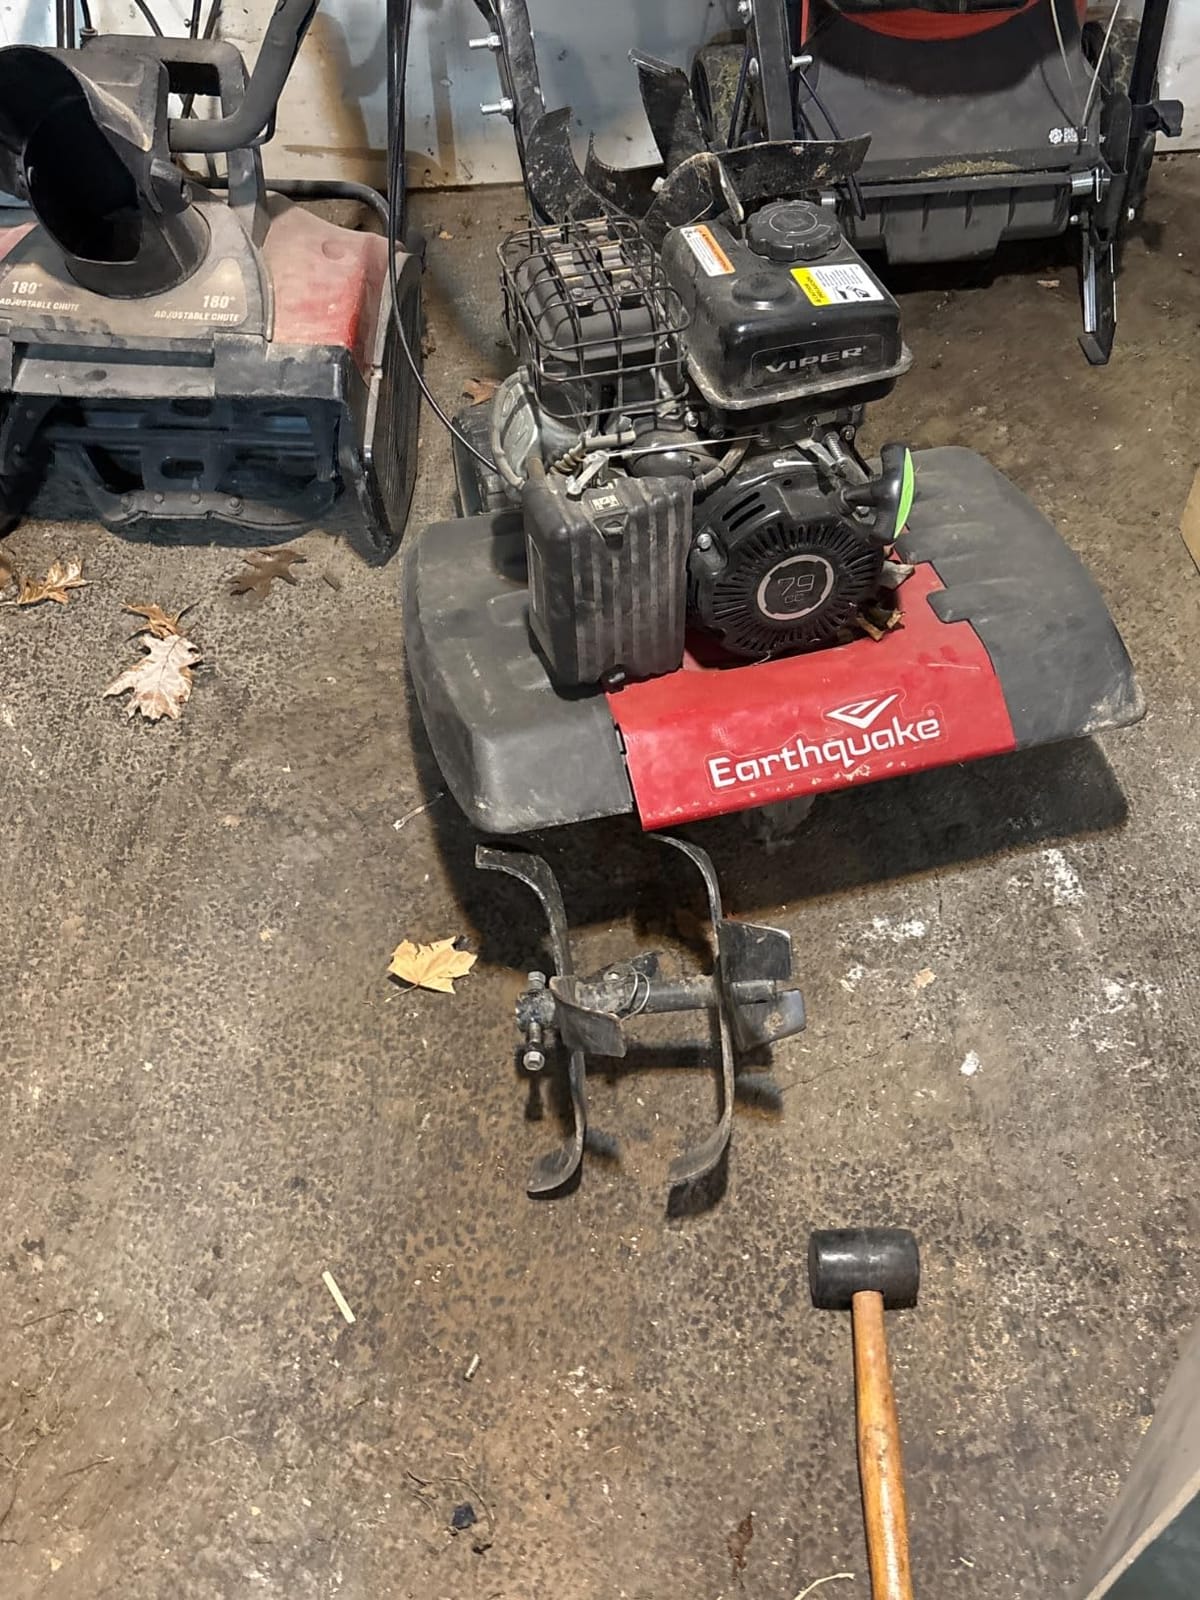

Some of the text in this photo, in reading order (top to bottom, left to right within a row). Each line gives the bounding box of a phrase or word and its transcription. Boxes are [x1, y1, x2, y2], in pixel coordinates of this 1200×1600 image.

[0, 297, 80, 312] ADJUSTABLE CHUTE
[154, 310, 241, 322] ADJUSTABLE CHUTE
[765, 346, 862, 373] VIPER
[777, 574, 815, 597] 79
[708, 716, 940, 788] Earthquake
